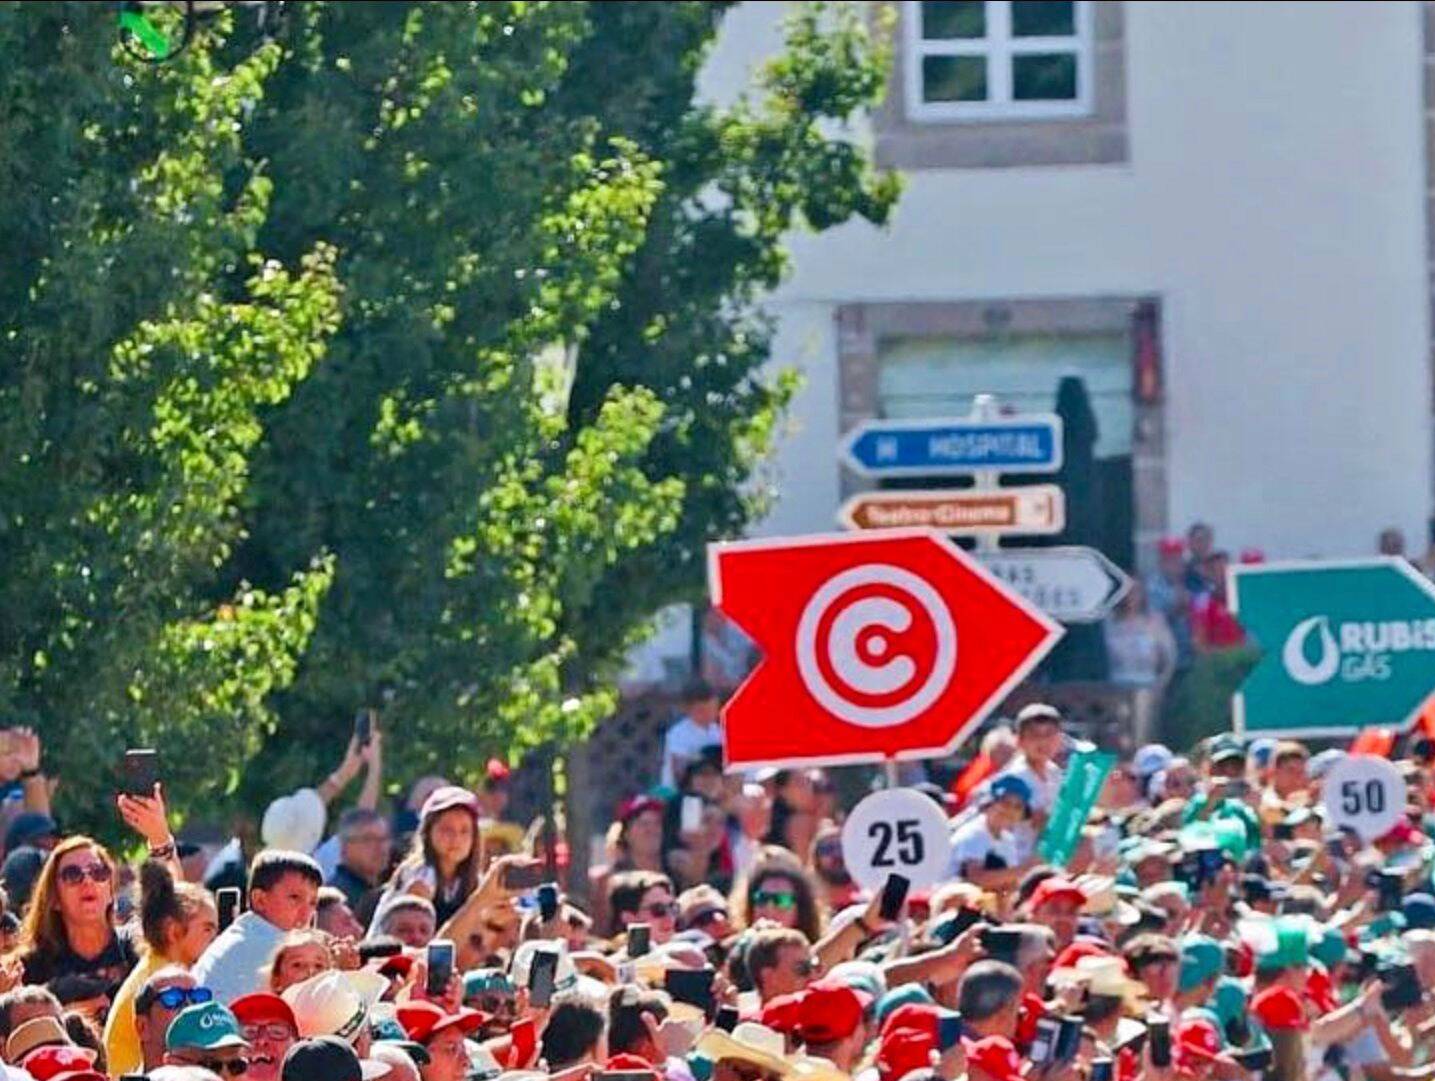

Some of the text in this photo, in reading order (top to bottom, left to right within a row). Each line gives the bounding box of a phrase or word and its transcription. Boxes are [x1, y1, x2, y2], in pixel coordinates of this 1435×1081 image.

[929, 433, 1047, 460] HOSPITAL
[1341, 779, 1385, 816] 50
[868, 818, 925, 867] 25
